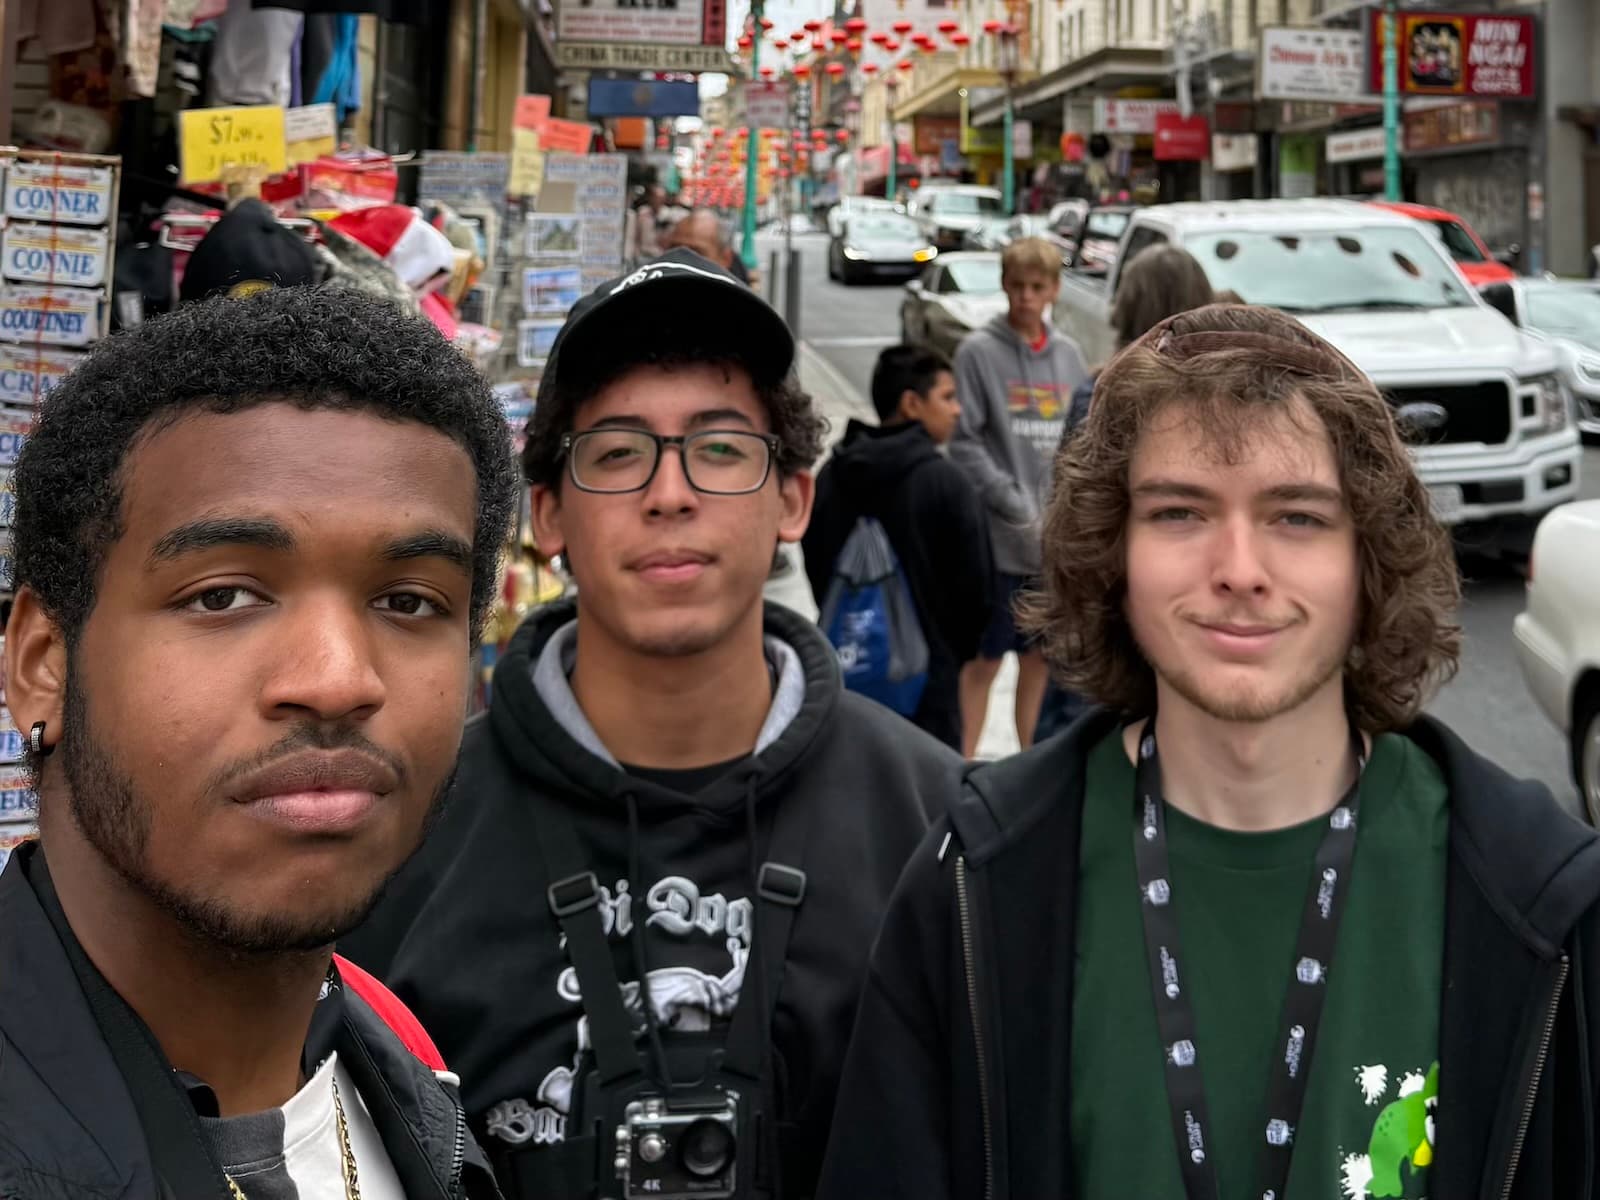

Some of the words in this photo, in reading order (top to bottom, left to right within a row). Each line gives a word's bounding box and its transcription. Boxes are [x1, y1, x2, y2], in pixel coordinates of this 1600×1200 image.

[15, 187, 99, 213] CONNER
[13, 248, 95, 275] CONNIE
[0, 370, 51, 393] CRA
[644, 875, 754, 949] Dog
[642, 1179, 661, 1192] 4K
